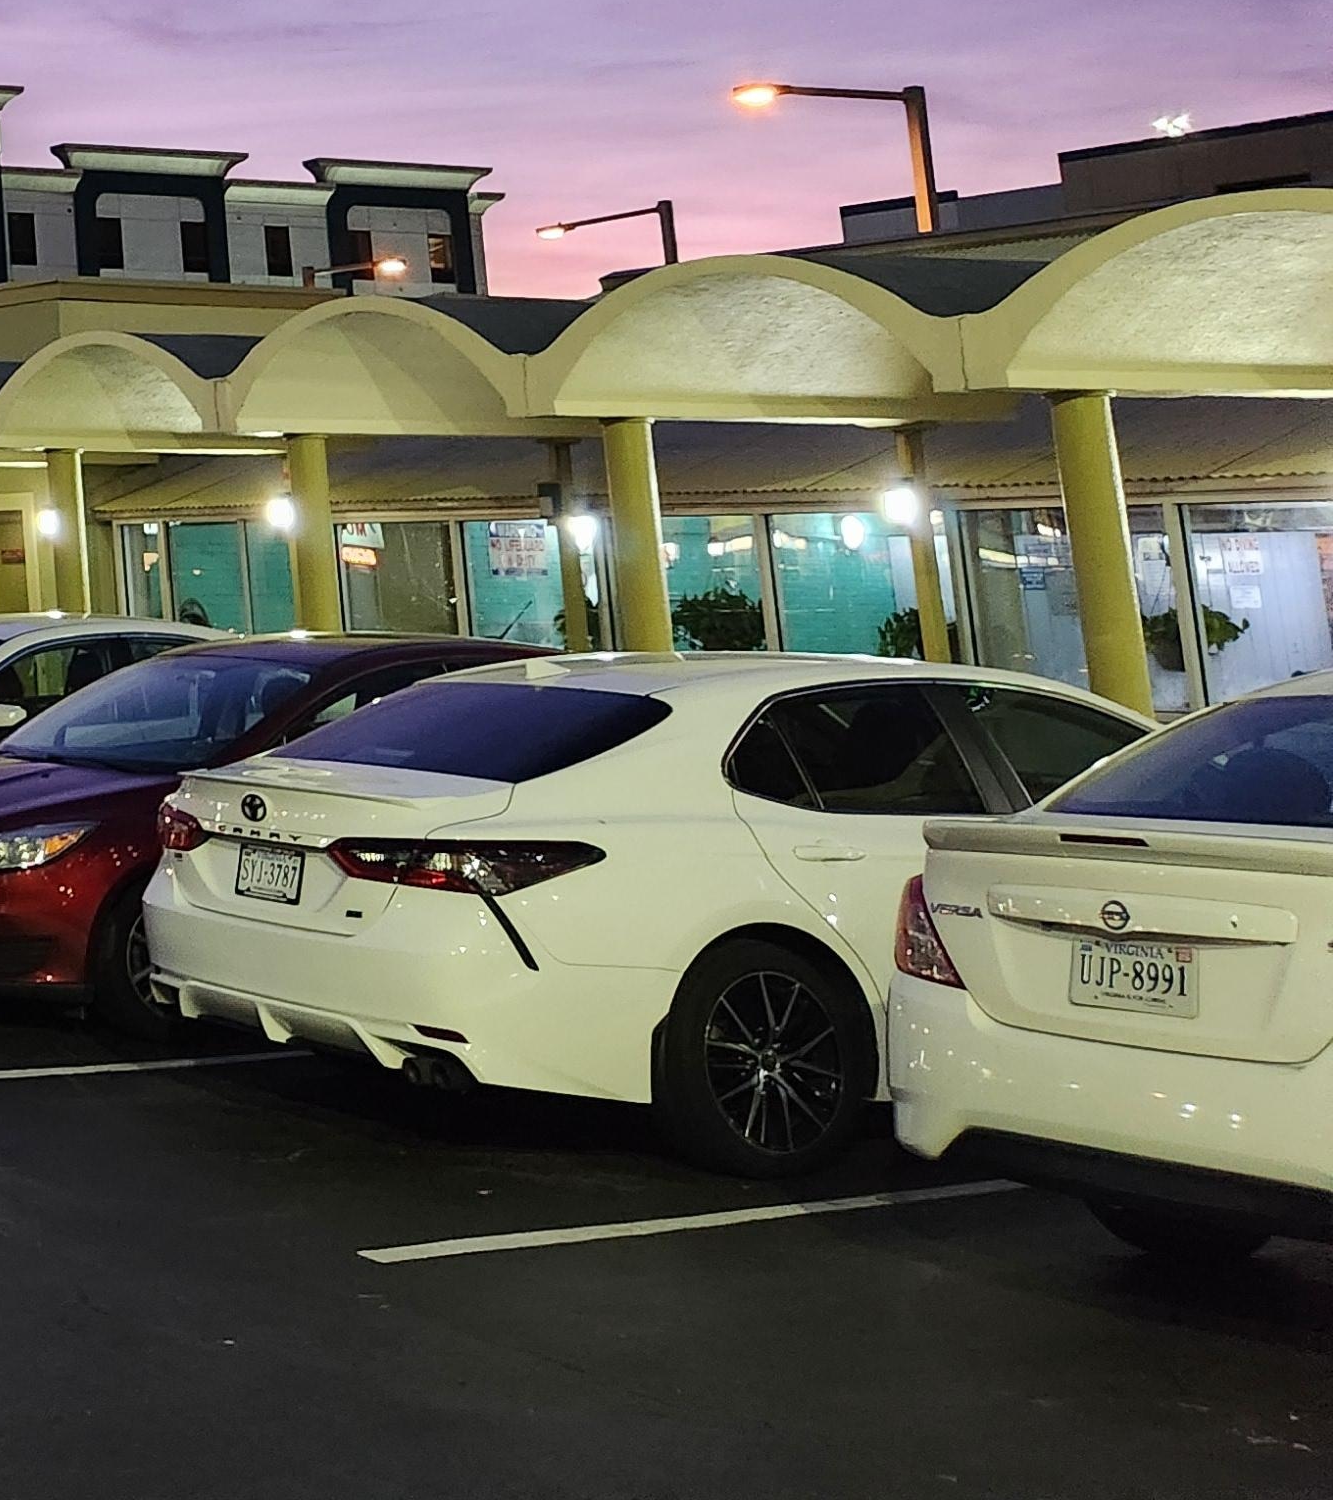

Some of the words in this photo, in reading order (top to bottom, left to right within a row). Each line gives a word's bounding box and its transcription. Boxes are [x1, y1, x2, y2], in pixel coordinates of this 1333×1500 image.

[241, 858, 298, 890] SYJ-3787
[931, 903, 983, 919] VERSA
[1104, 942, 1165, 960] VIRGINIA
[1080, 953, 1188, 997] UJP-8991
